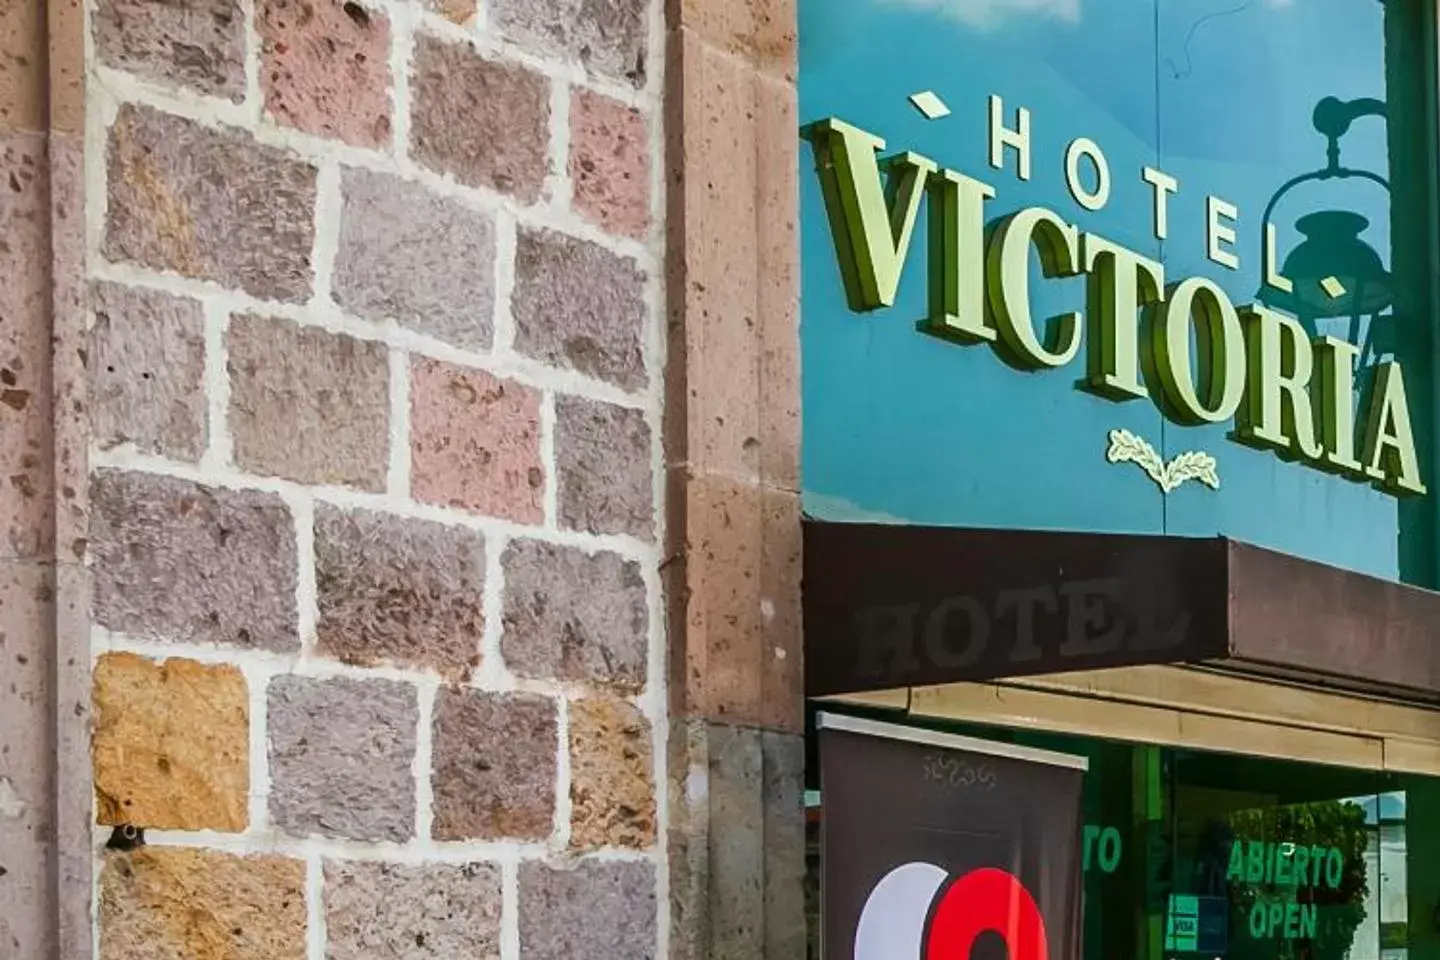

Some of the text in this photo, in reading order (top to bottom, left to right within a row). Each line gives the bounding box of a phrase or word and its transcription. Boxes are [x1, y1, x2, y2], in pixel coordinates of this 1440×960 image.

[987, 93, 1294, 294] HOTEL
[799, 116, 1427, 498] VICTORIA
[1225, 839, 1344, 889] ABIERTO
[1248, 900, 1318, 940] OPEN
